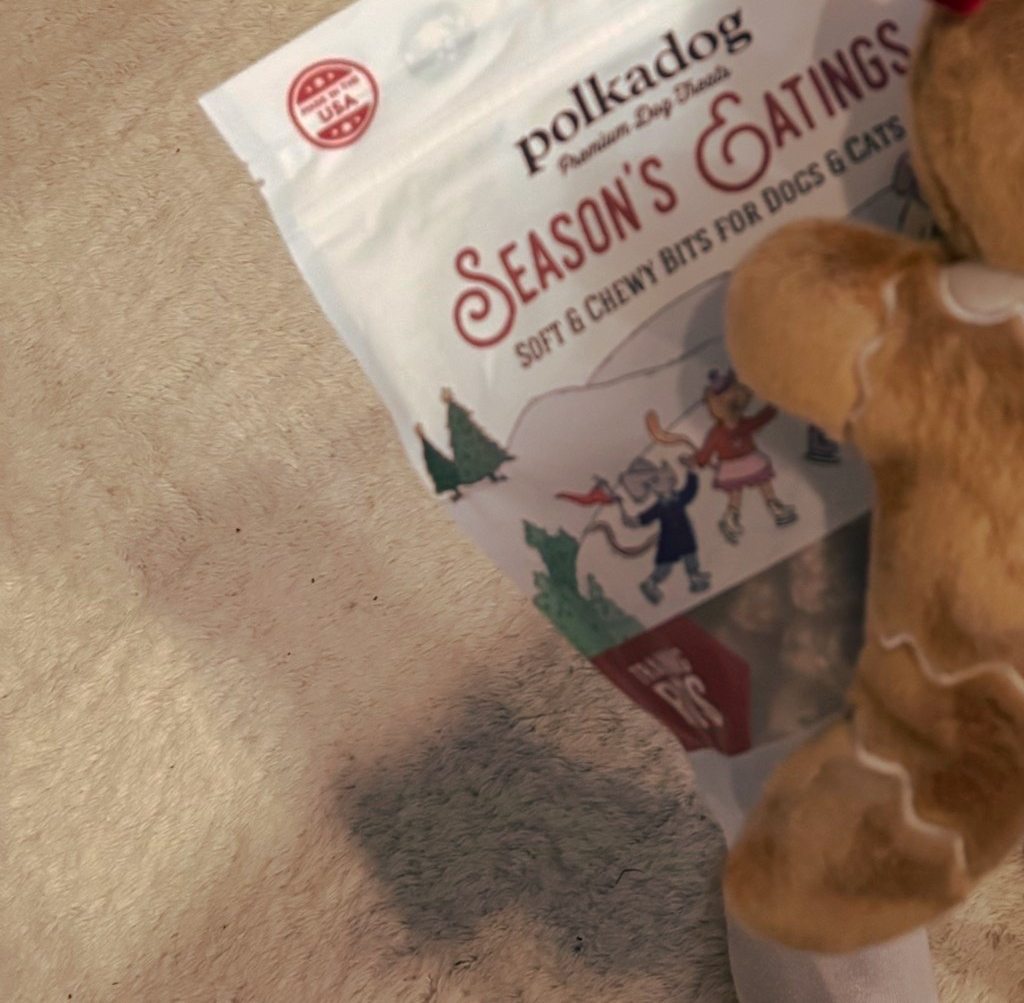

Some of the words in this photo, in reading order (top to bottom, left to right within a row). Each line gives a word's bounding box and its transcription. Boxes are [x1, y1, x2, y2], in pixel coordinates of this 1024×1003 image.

[317, 93, 359, 123] USA
[515, 5, 753, 176] polkadog
[558, 122, 630, 175] Premium
[634, 99, 674, 129] Dog
[674, 64, 732, 104] Treats
[453, 156, 678, 349] SEASON'S
[695, 19, 911, 193] EATINGS
[514, 318, 566, 369] SOFT
[564, 307, 587, 335] &
[583, 259, 658, 322] CHEWY
[658, 227, 714, 275] BITS
[713, 200, 763, 243] FOR
[761, 161, 826, 215] DOGS
[823, 148, 847, 177] &
[844, 114, 907, 165] CATS
